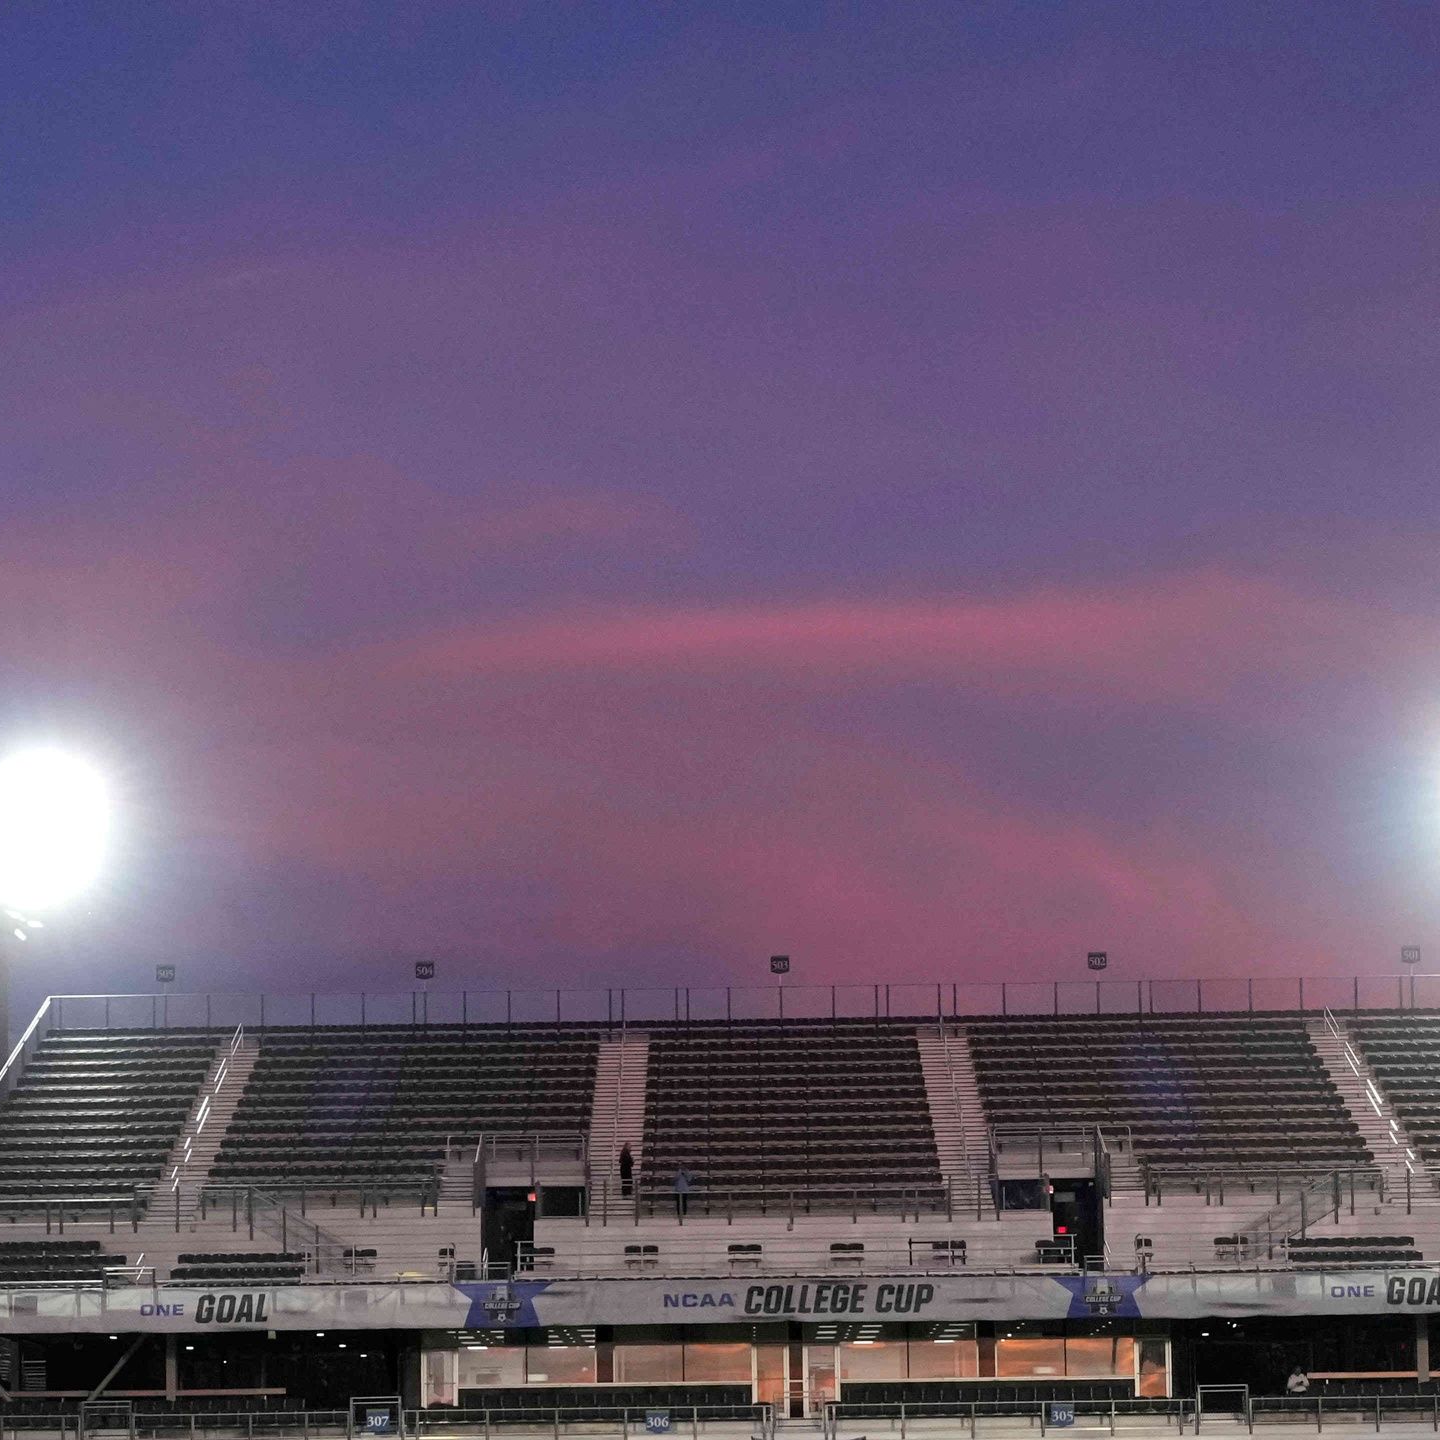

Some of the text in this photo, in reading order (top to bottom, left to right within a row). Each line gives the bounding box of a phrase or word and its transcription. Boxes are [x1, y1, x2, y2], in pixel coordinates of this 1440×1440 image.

[417, 966, 433, 976] 504
[1330, 1285, 1375, 1298] ONE
[663, 1284, 935, 1314] NCAA COLLEGE CUP
[140, 1293, 268, 1324] ONE GOAL
[367, 1415, 389, 1427] 307
[646, 1416, 669, 1428] 306
[1052, 1410, 1074, 1422] 305
